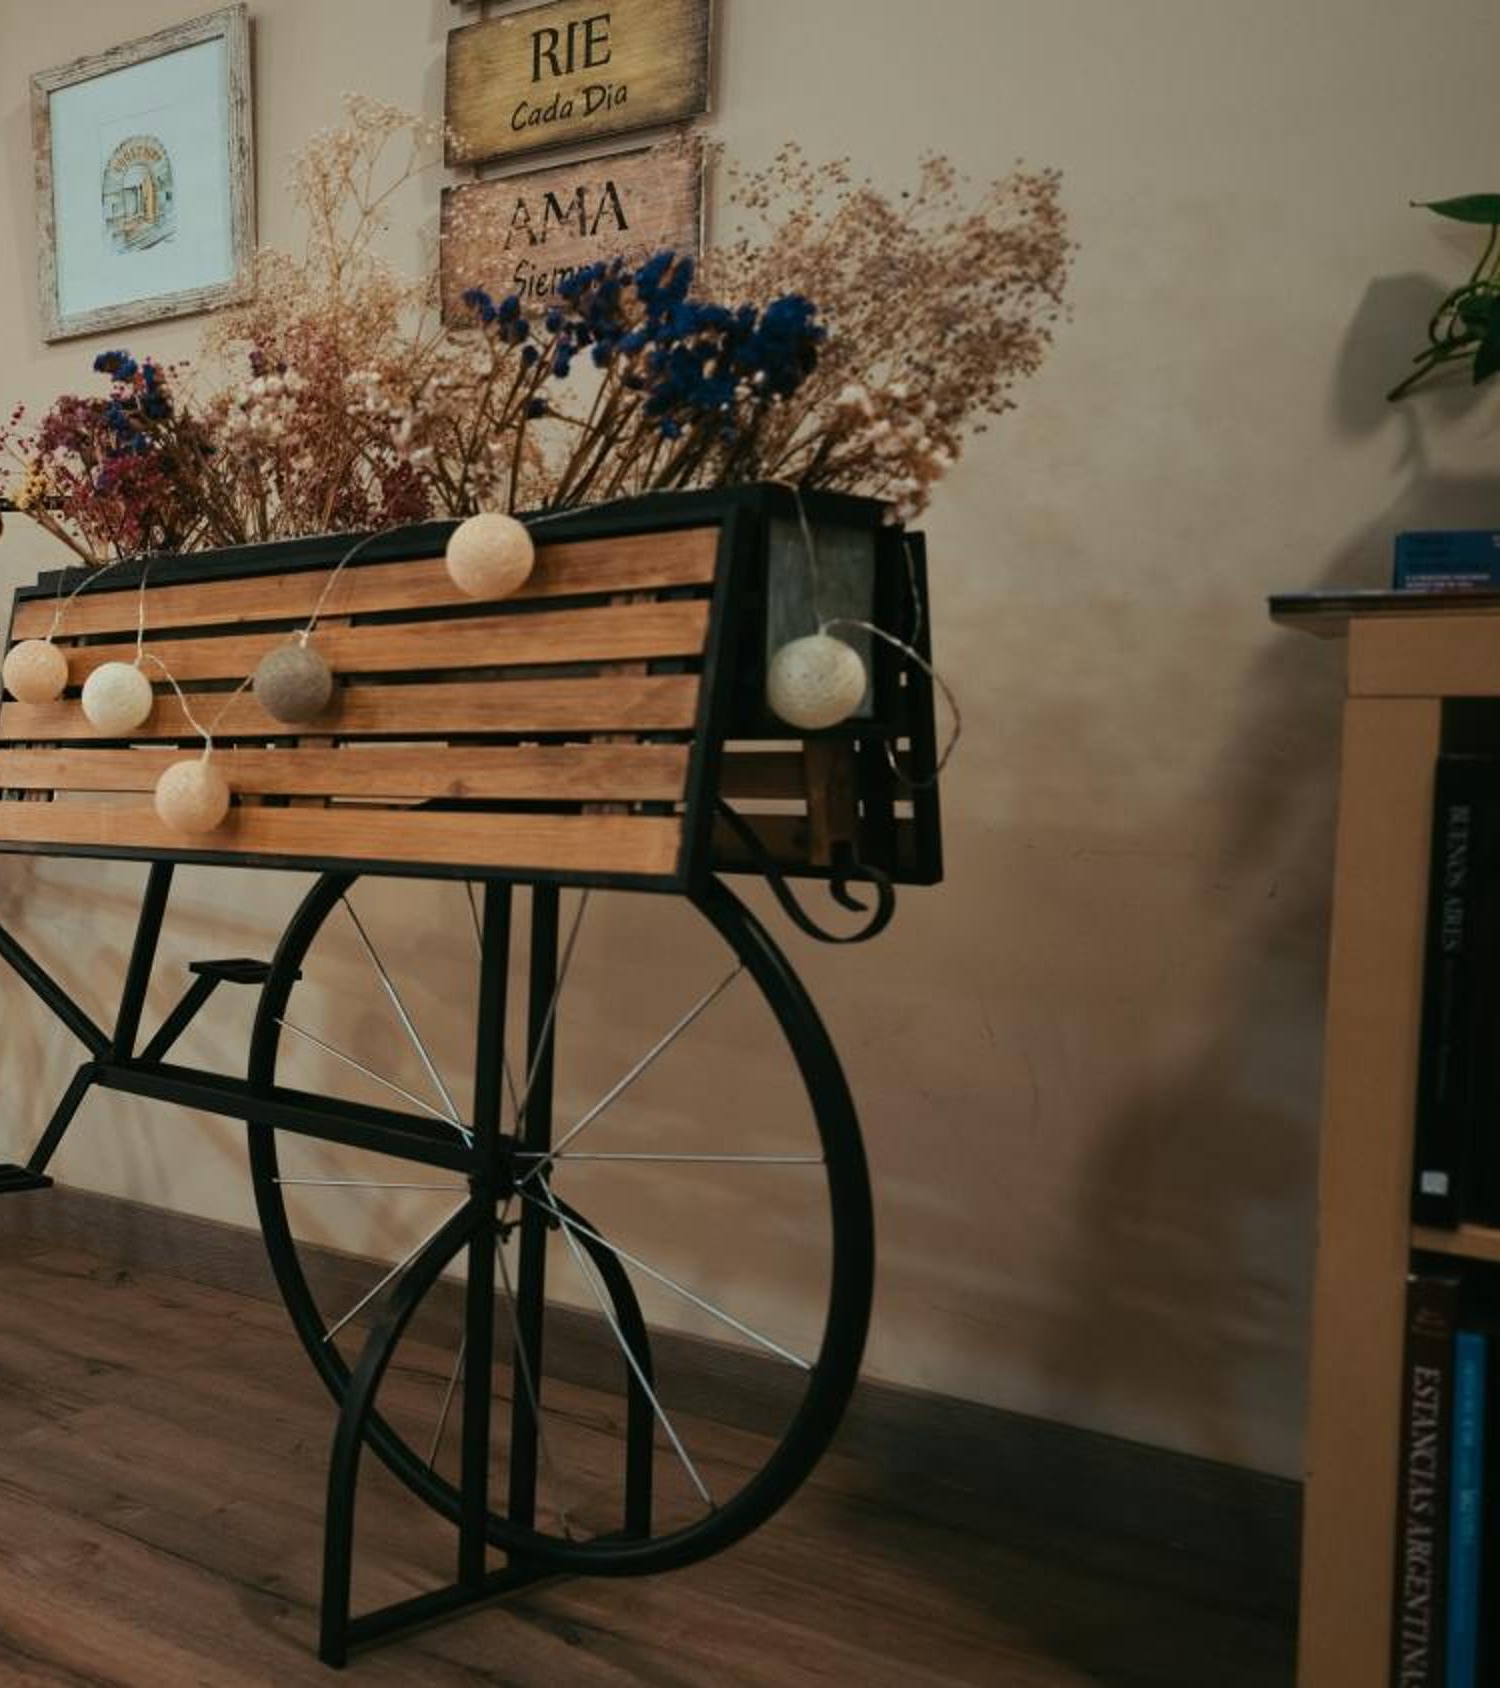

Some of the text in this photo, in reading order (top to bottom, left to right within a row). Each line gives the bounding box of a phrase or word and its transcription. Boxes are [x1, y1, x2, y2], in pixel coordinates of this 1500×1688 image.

[531, 13, 612, 83] RIE
[511, 84, 628, 132] Cada Dia
[503, 180, 629, 250] AMA
[1409, 1365, 1440, 1514] ESTANCIAS
